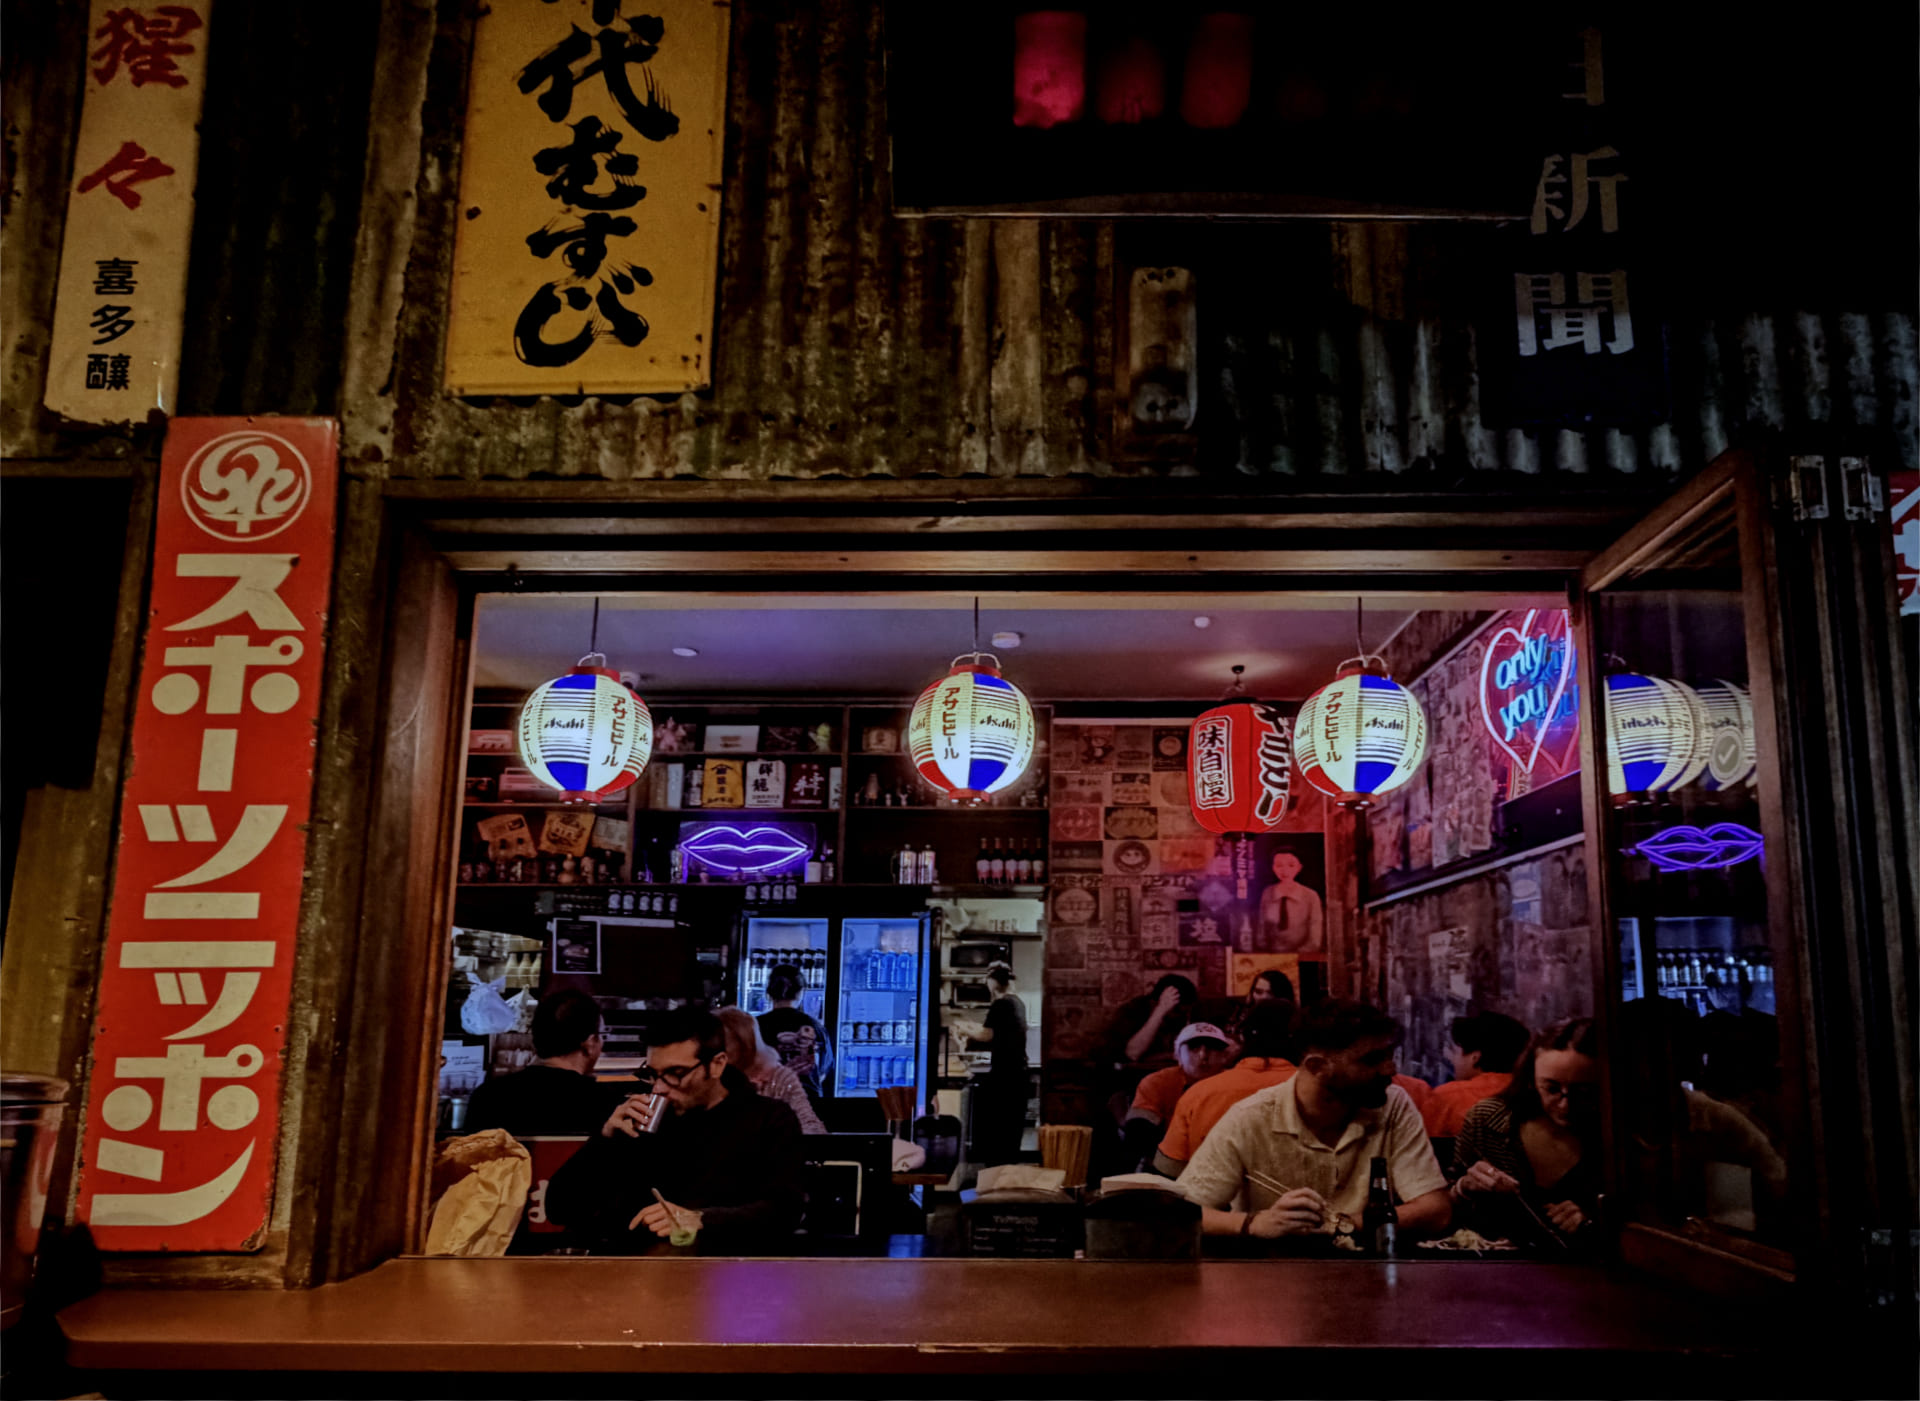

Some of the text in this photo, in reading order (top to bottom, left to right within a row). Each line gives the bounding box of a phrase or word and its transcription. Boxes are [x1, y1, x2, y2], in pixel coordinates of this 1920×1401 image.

[512, 0, 682, 367] 代むすび
[1495, 633, 1548, 690] only
[544, 717, 585, 730] Asahi
[602, 694, 627, 767] アサヒビール
[942, 686, 960, 760] アサヒビール
[980, 714, 1017, 731] Asahi
[1325, 690, 1345, 763] アサヒビール
[1365, 716, 1405, 731] Asahi
[1499, 682, 1549, 742] you
[1198, 724, 1225, 799] 味自慢
[90, 553, 306, 1228] スポーツニッポン
